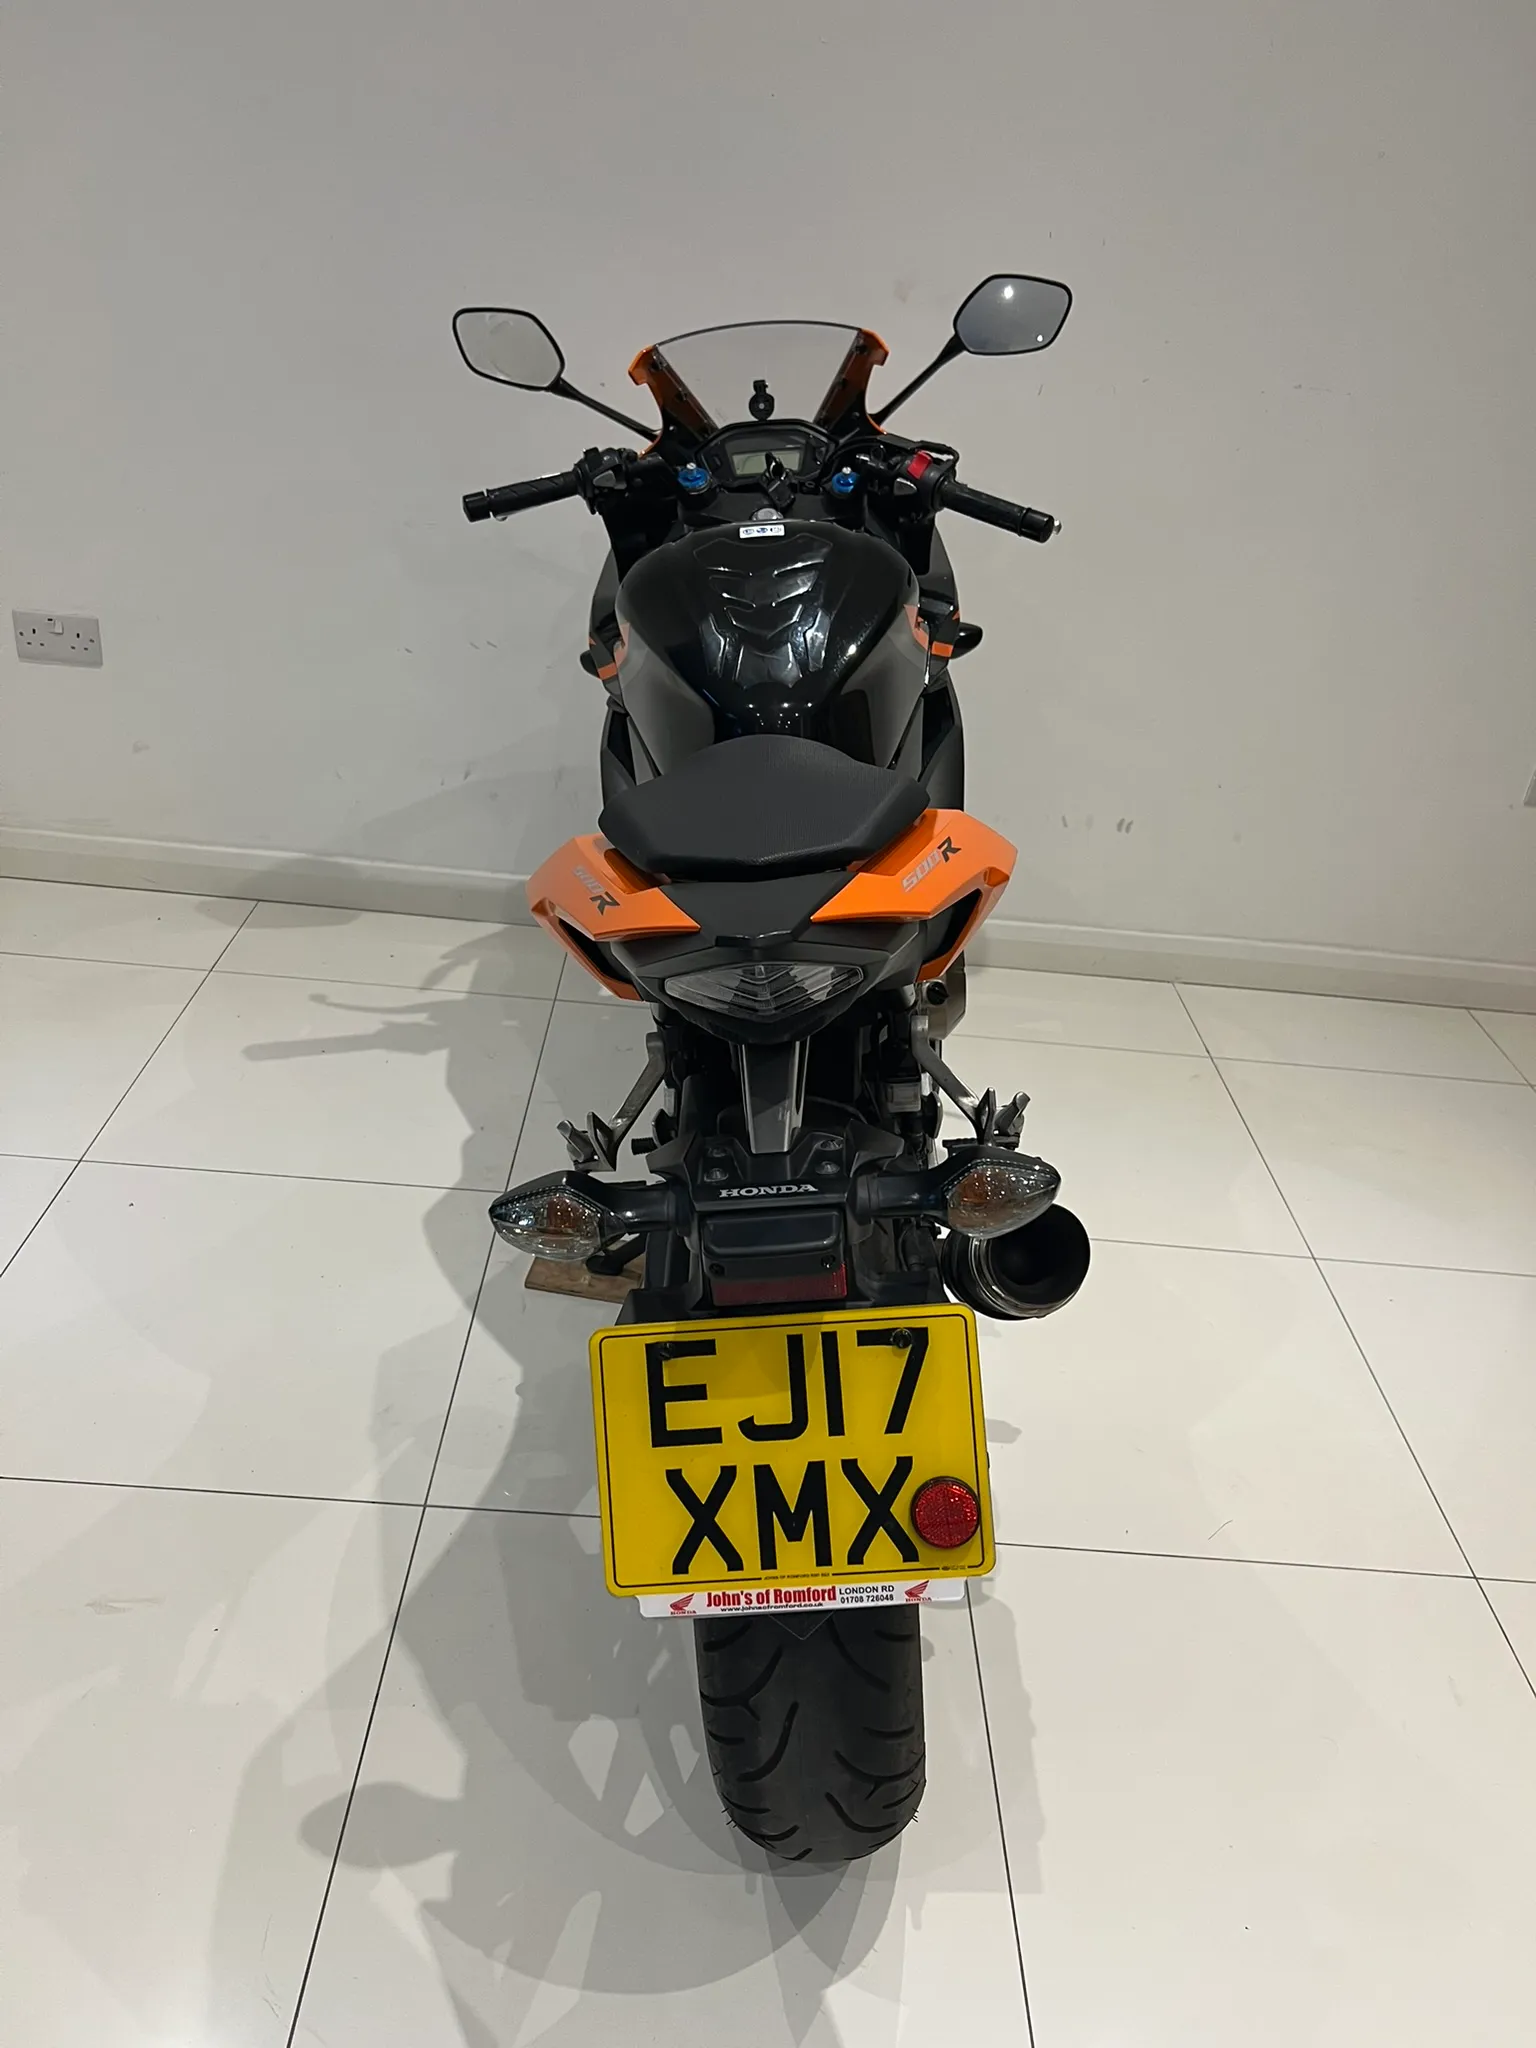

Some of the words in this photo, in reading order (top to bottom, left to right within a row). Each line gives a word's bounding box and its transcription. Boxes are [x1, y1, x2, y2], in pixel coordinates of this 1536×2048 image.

[719, 1184, 819, 1198] HONDA
[645, 1327, 929, 1448] EJ17
[665, 1455, 920, 1575] XMX
[707, 1590, 753, 1608] John's
[757, 1589, 771, 1604] of
[773, 1585, 837, 1604] Romford
[839, 1586, 877, 1595] LONDON
[881, 1585, 895, 1593] RD
[840, 1595, 864, 1604] 01708
[720, 1602, 824, 1612] www.johnsofromford.co.uk
